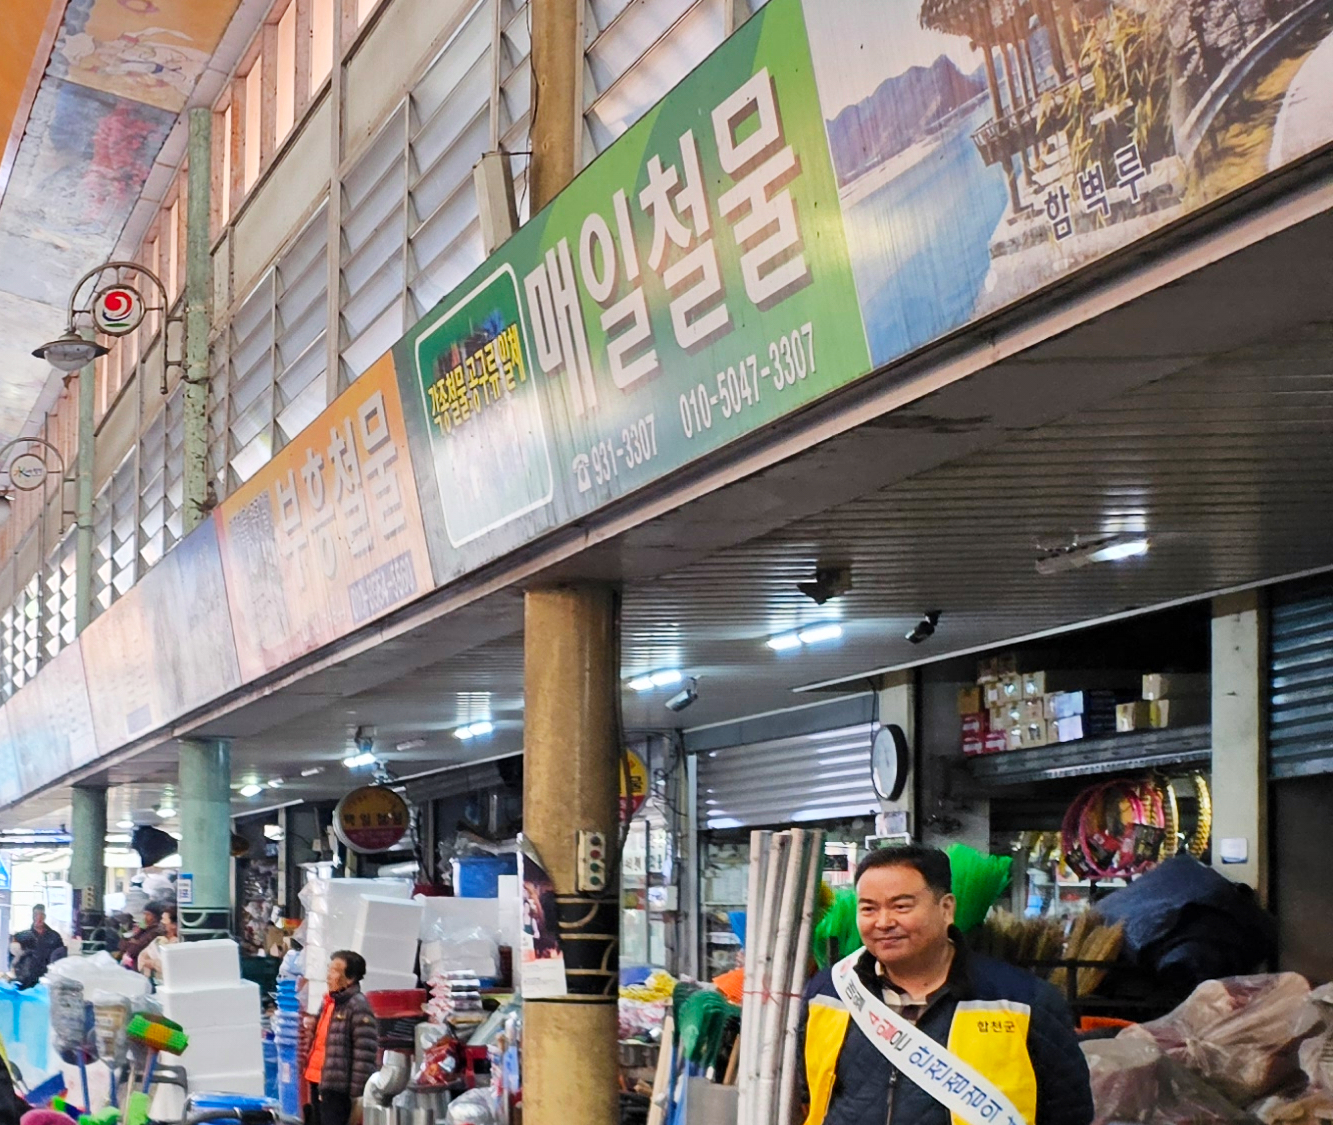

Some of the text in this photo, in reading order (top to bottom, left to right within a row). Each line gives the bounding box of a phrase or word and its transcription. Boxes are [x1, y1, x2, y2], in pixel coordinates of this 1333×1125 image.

[523, 66, 809, 417] 매일철물
[1044, 142, 1153, 242] 함벽루
[592, 322, 817, 487] 931-3307 010-5047-3307
[275, 390, 409, 592] 부흥철물
[868, 1010, 912, 1052] 4일은
[908, 1045, 1003, 1123] 안전점검의
[977, 1020, 1016, 1034] 합천군
